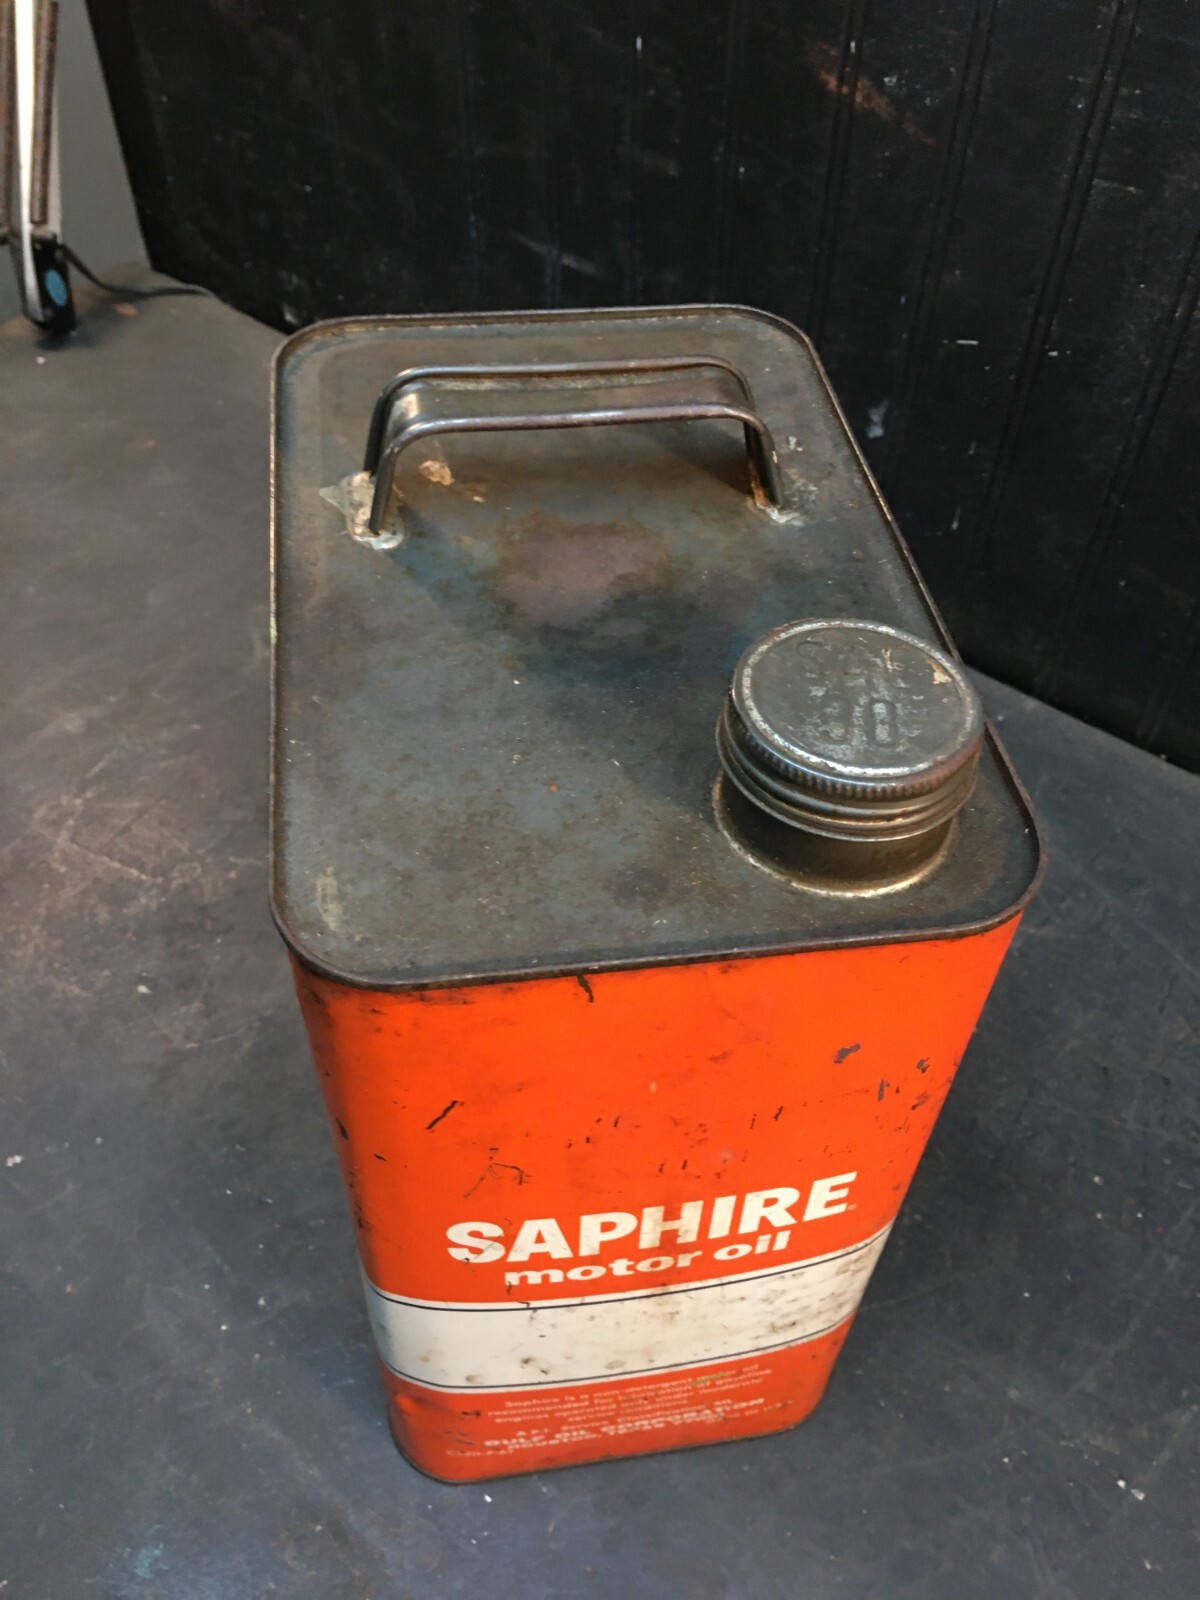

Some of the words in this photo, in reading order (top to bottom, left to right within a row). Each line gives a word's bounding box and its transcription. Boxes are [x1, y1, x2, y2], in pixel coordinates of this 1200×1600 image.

[446, 1172, 857, 1265] SAPHIRE
[504, 1249, 702, 1286] motor
[713, 1230, 790, 1261] oil
[484, 1434, 546, 1448] GULF
[554, 1429, 592, 1441] OIL
[600, 1397, 765, 1433] CORPORATION
[487, 1399, 590, 1417] recommended
[594, 1397, 614, 1405] for
[495, 1412, 550, 1425] engines
[554, 1402, 617, 1418] operated
[654, 1391, 694, 1404] under
